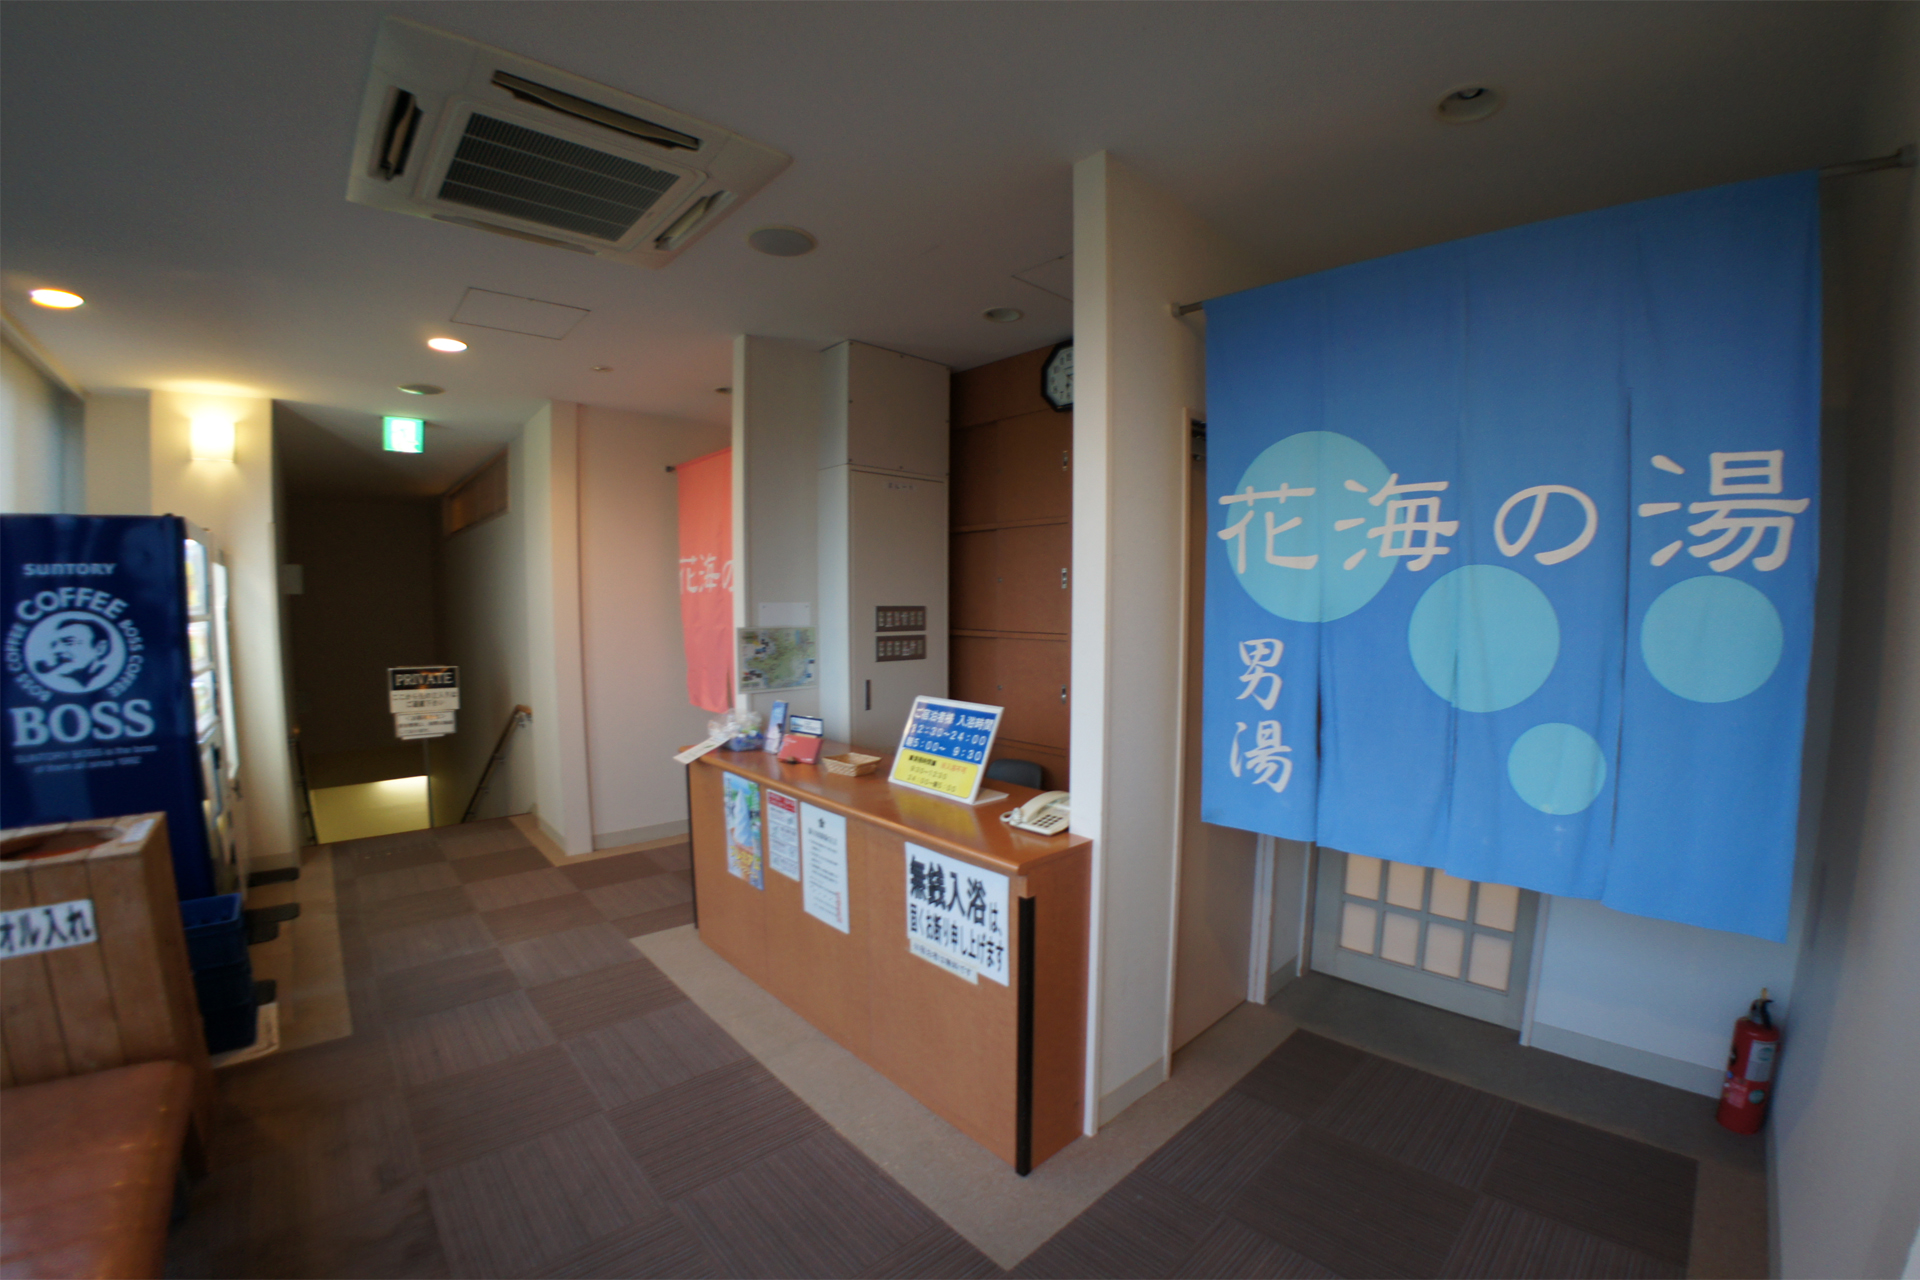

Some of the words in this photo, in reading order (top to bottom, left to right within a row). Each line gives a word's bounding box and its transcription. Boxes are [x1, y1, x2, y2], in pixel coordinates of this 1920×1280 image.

[1217, 449, 1810, 574] 花海の湯
[16, 586, 129, 622] COFFEE
[4, 621, 28, 673] COFFEE
[117, 618, 145, 652] BOSS
[13, 672, 53, 703] BOSS
[106, 653, 145, 698] COFFEE
[394, 672, 455, 687] PRIVATE
[8, 699, 156, 747] BOSS
[1228, 637, 1294, 794] 男湯
